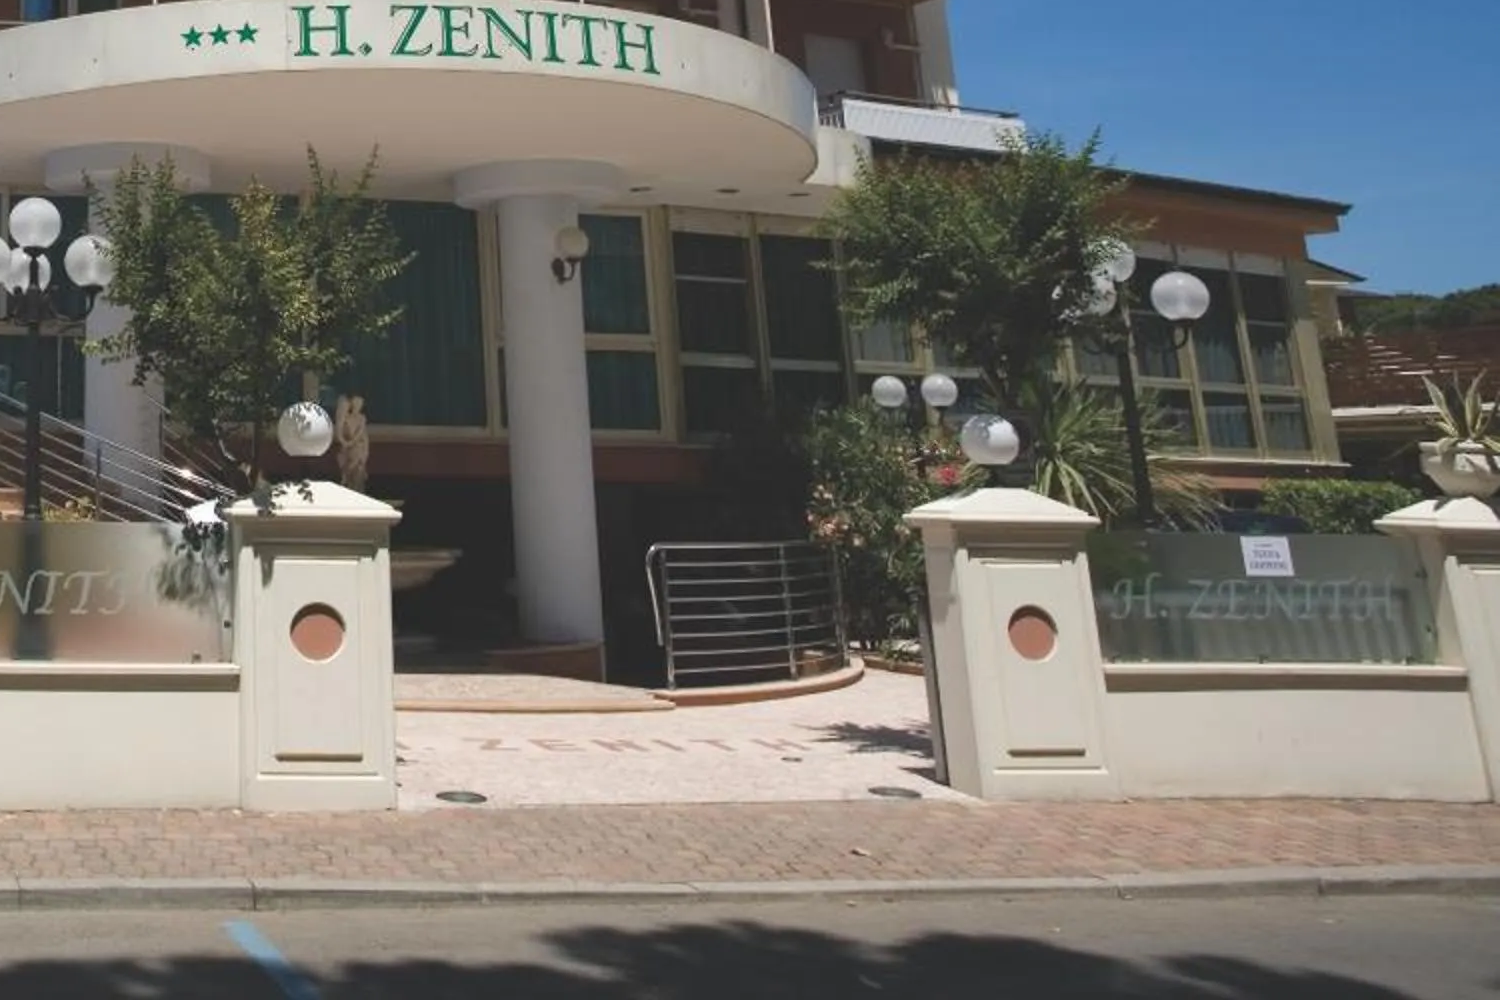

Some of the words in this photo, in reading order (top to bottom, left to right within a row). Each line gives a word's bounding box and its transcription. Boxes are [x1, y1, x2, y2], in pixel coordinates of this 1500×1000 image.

[291, 4, 373, 57] H.
[390, 4, 661, 75] ZENITH
[1109, 571, 1168, 620] H.
[1187, 577, 1396, 621] ZENITH
